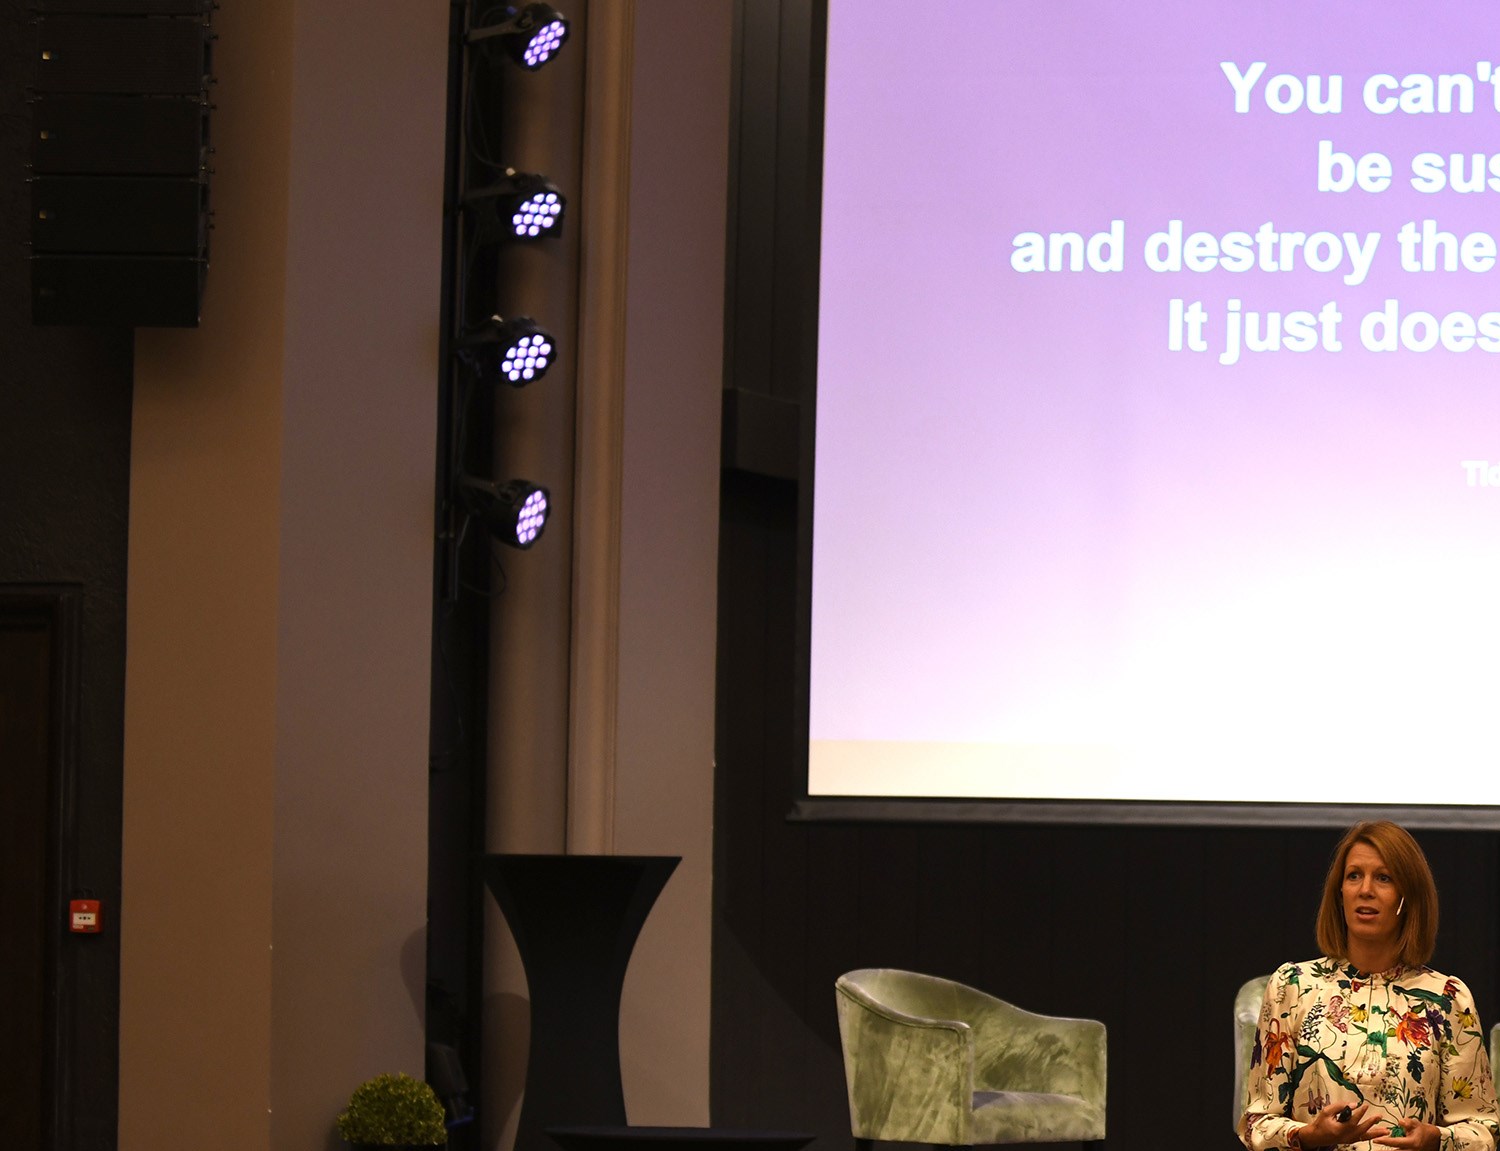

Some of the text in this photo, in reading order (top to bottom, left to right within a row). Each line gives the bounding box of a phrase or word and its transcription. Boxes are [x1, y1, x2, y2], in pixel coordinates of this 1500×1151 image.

[1220, 61, 1343, 114] You
[1317, 140, 1392, 193] be
[1010, 220, 1124, 273] and
[1144, 220, 1381, 286] destroy
[1397, 220, 1497, 273] the
[1168, 299, 1207, 352] It
[1218, 299, 1343, 366] just
